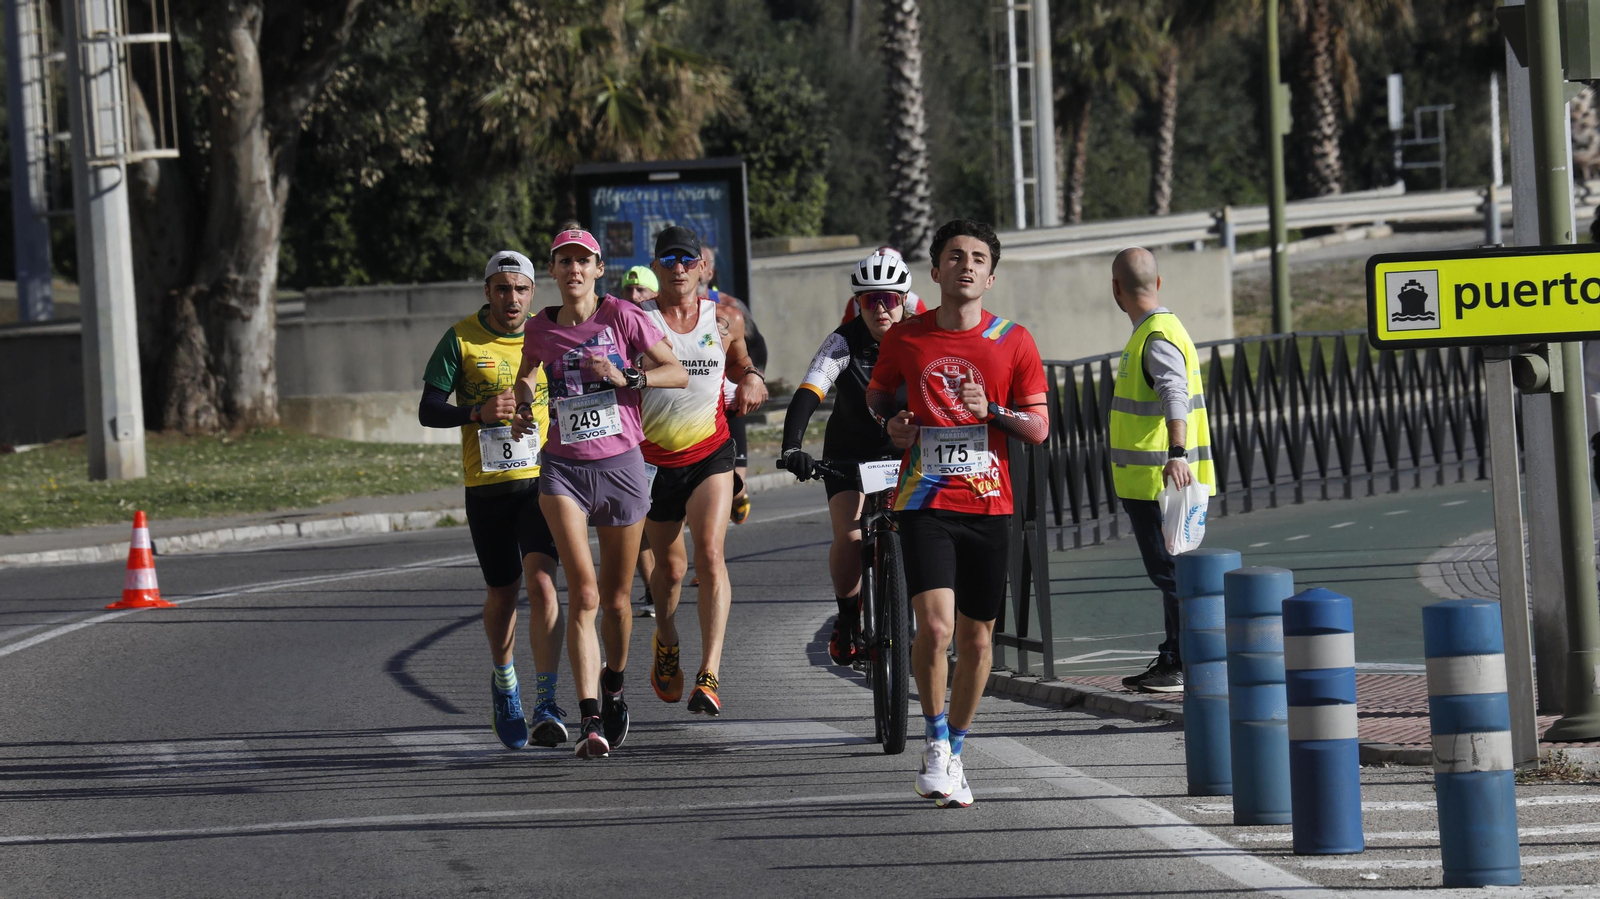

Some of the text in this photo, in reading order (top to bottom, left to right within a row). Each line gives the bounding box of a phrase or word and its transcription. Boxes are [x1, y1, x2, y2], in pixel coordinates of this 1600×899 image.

[594, 186, 660, 212] Algeciras
[1454, 271, 1600, 320] puerto
[569, 409, 601, 432] 249
[576, 429, 607, 440] EVOS
[502, 442, 513, 460] 8
[934, 443, 969, 464] 175
[497, 460, 528, 470] EVOS
[939, 465, 972, 474] EVOS
